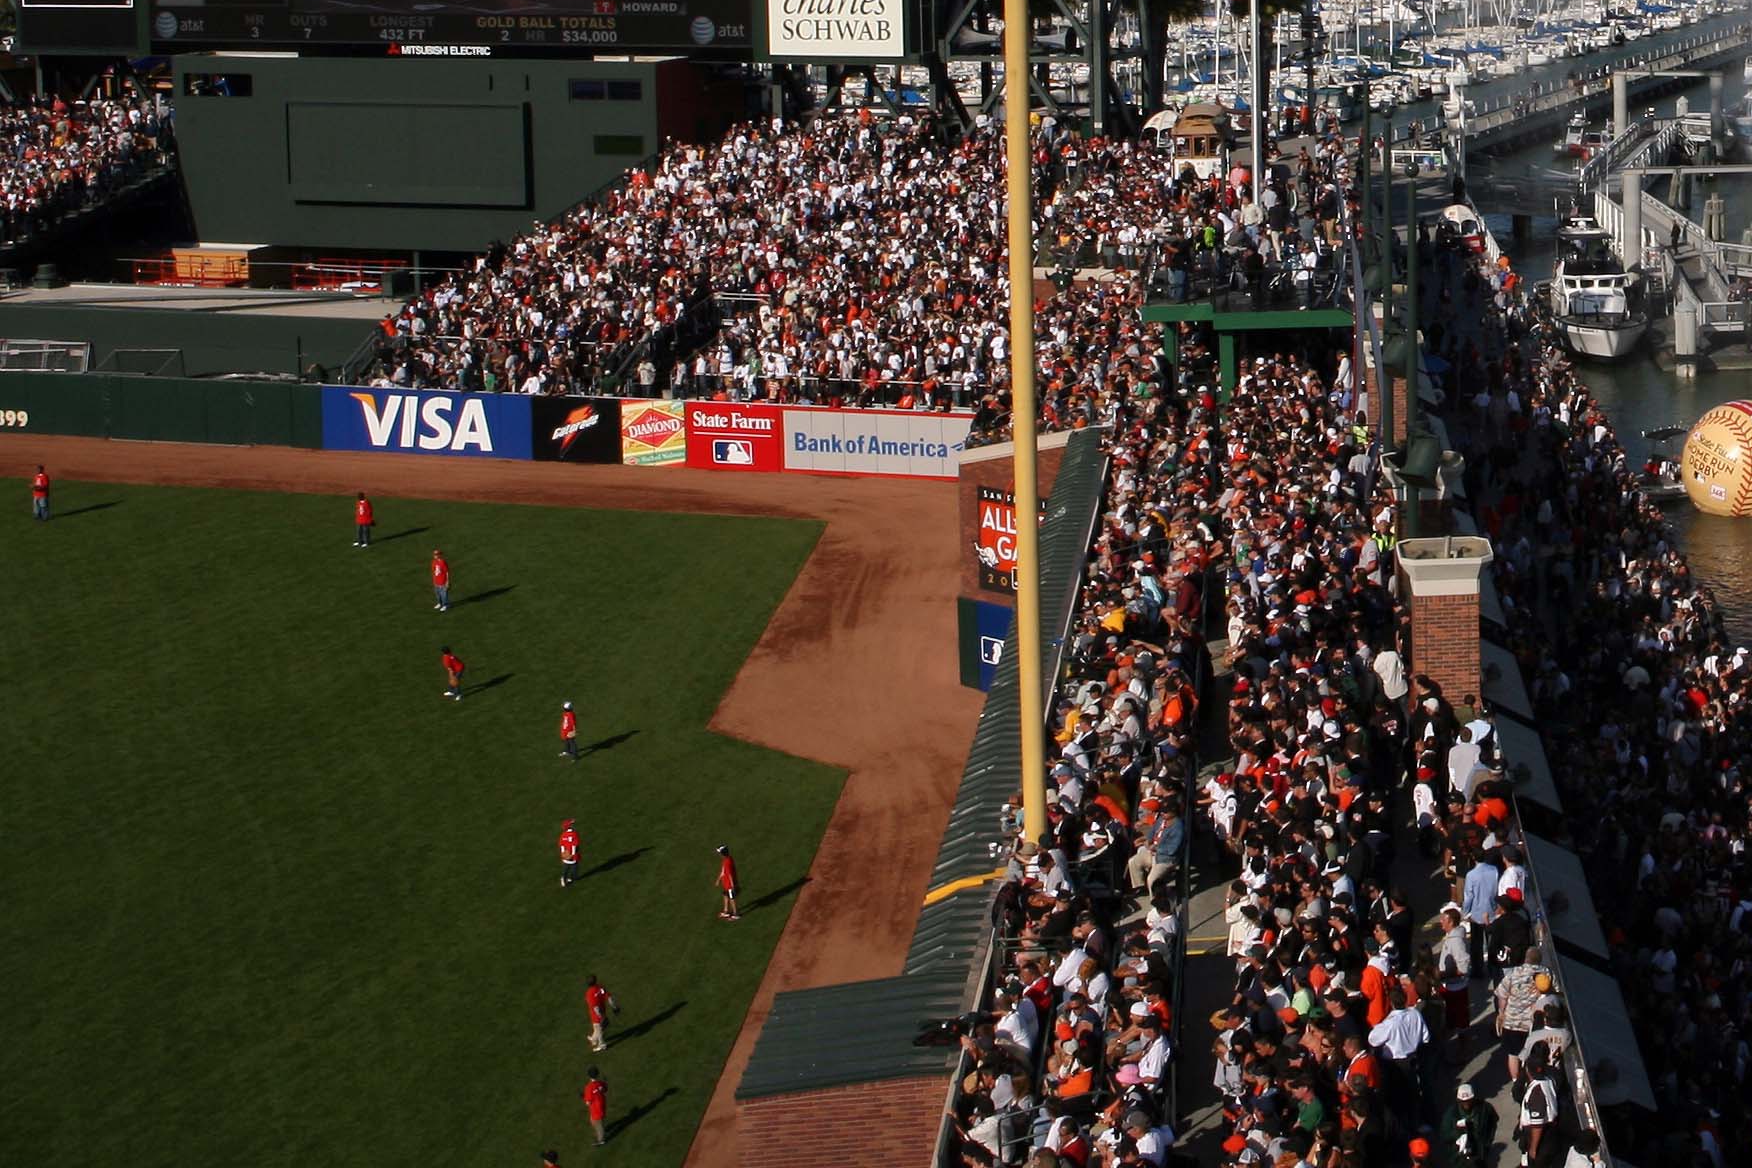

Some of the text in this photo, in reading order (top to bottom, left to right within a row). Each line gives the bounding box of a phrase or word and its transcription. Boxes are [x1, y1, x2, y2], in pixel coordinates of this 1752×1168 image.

[622, 2, 678, 12] HOWARD
[244, 15, 265, 25] HR
[290, 15, 328, 26] OUTS
[369, 16, 435, 27] LONGEST
[476, 17, 617, 29] GOLD BALL TOTALS
[250, 27, 260, 38] 3
[303, 27, 312, 39] 7
[379, 29, 425, 40] 432 FT
[501, 30, 510, 42] 2
[525, 30, 546, 42] HR
[562, 29, 618, 43] $34,000
[781, 18, 892, 42] SCHWAB
[401, 45, 491, 56] MITSUBISHI ELECTRIC
[350, 392, 494, 452] VISA
[692, 410, 772, 431] State Farm
[628, 418, 681, 438] DIAMOND
[793, 432, 948, 458] Bank of America
[1714, 442, 1738, 464] Fa
[1688, 454, 1719, 479] DERBY
[1710, 457, 1735, 475] RUN
[983, 489, 1002, 500] SAN
[982, 505, 1016, 534] ALL
